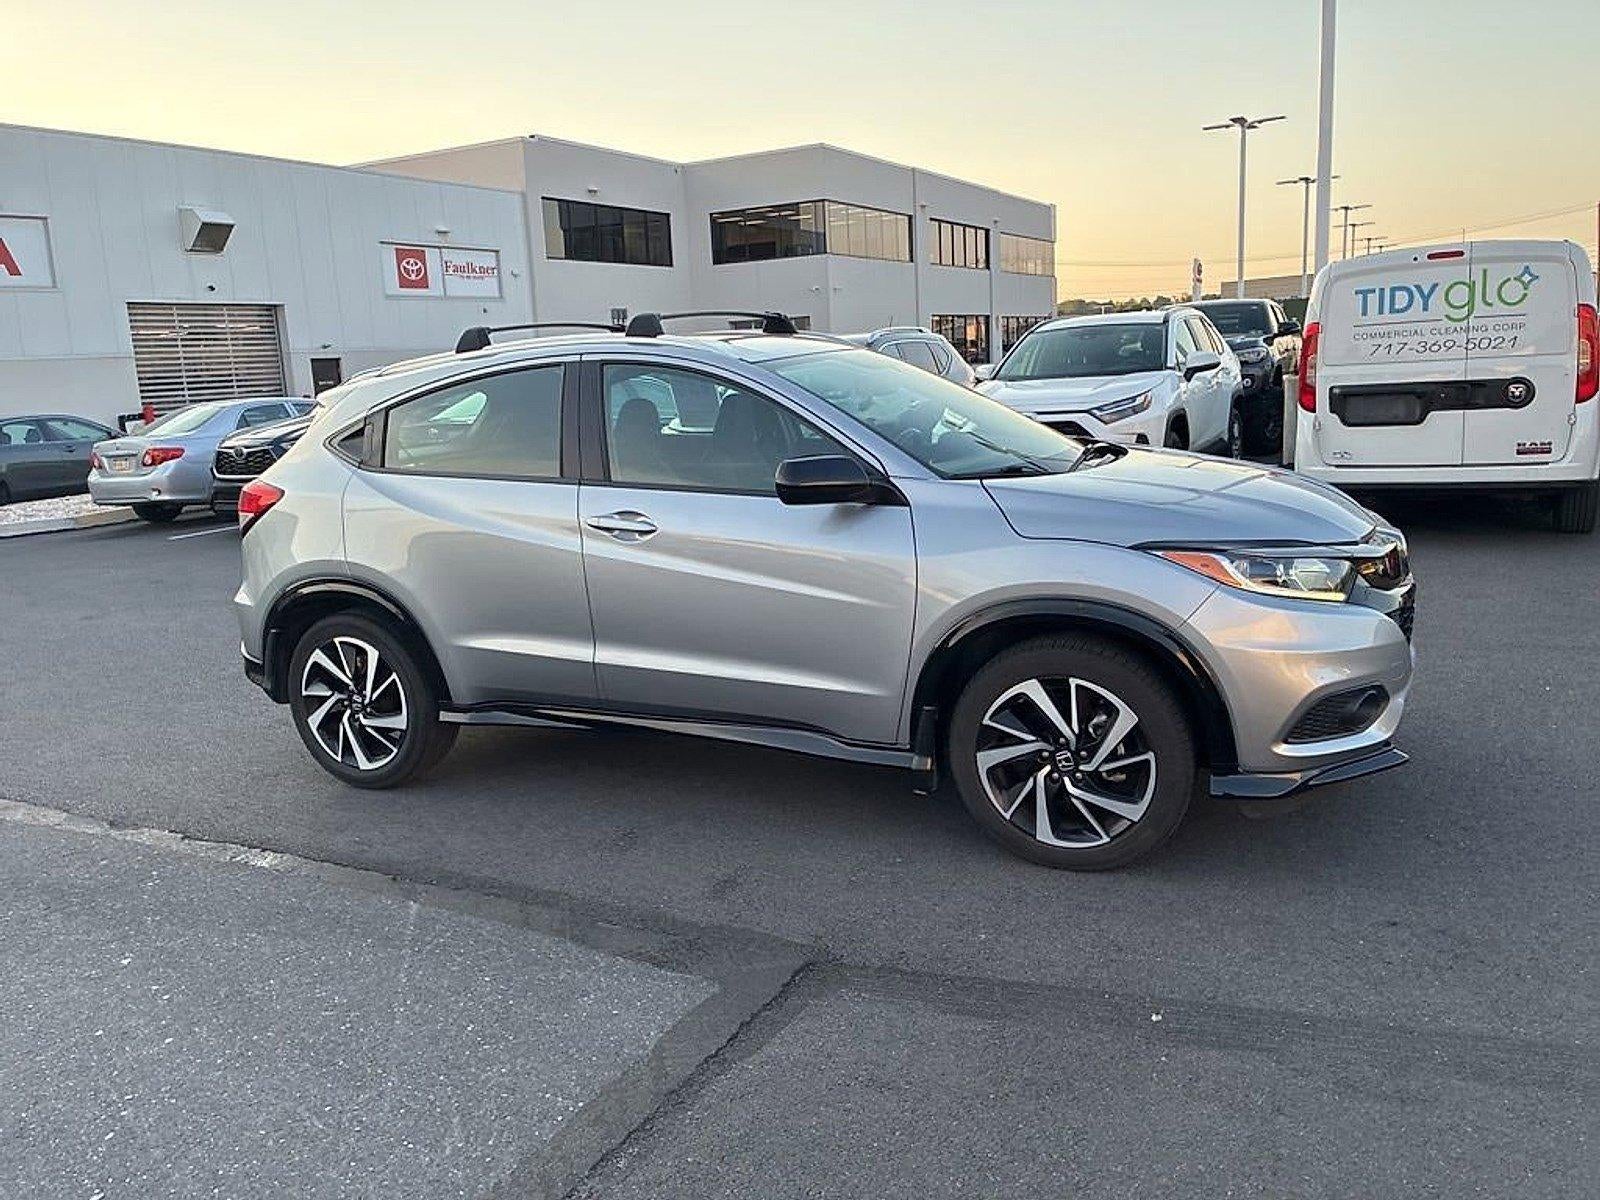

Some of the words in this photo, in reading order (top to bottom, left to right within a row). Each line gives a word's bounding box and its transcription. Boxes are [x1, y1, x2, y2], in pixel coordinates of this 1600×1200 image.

[444, 261, 496, 275] Faulkner
[1353, 326, 1426, 341] COMMERCIAL
[1429, 324, 1489, 336] CLEANING
[1493, 322, 1526, 332] CORP
[1369, 335, 1519, 356] 717-369-5021
